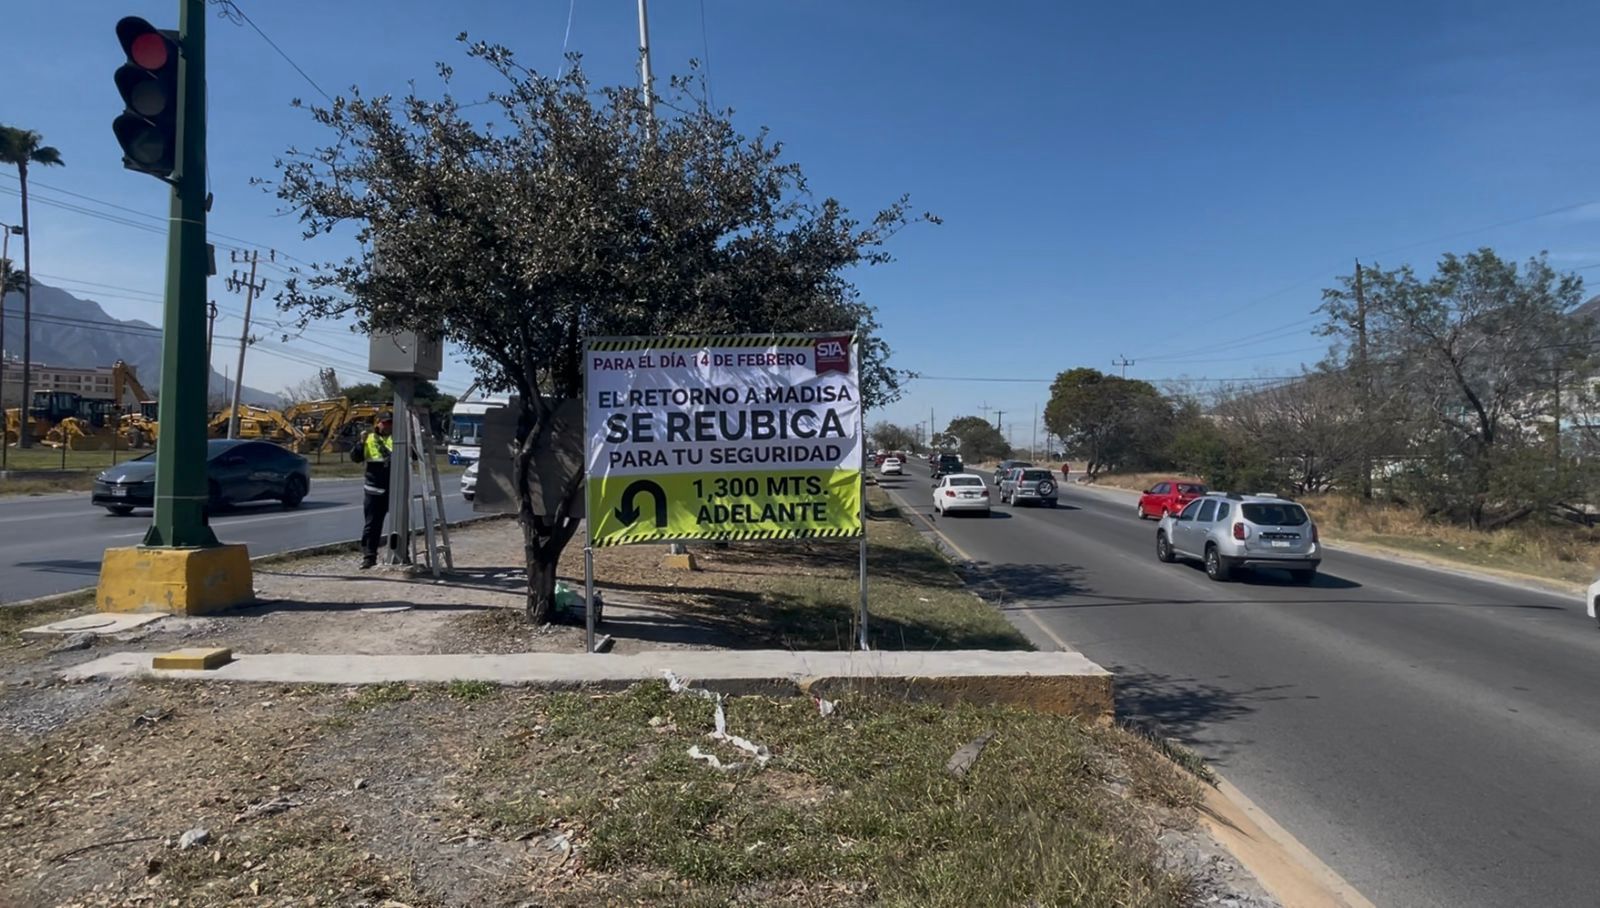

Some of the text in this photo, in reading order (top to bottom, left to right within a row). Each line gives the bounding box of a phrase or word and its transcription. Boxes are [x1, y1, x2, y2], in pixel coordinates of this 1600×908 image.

[593, 358, 635, 370] PARA
[638, 355, 655, 369] EL
[660, 352, 687, 368] DÍA
[691, 354, 709, 367] 14
[714, 354, 733, 367] DE
[737, 353, 807, 366] FEBRERO
[599, 385, 852, 408] EL RETORNO A MADISA
[606, 408, 846, 443] SE REUBICA
[610, 445, 841, 468] PARA TU SEGURIDAD
[693, 475, 829, 503] 1,300 MTS.
[697, 501, 827, 524] ADELANTE
